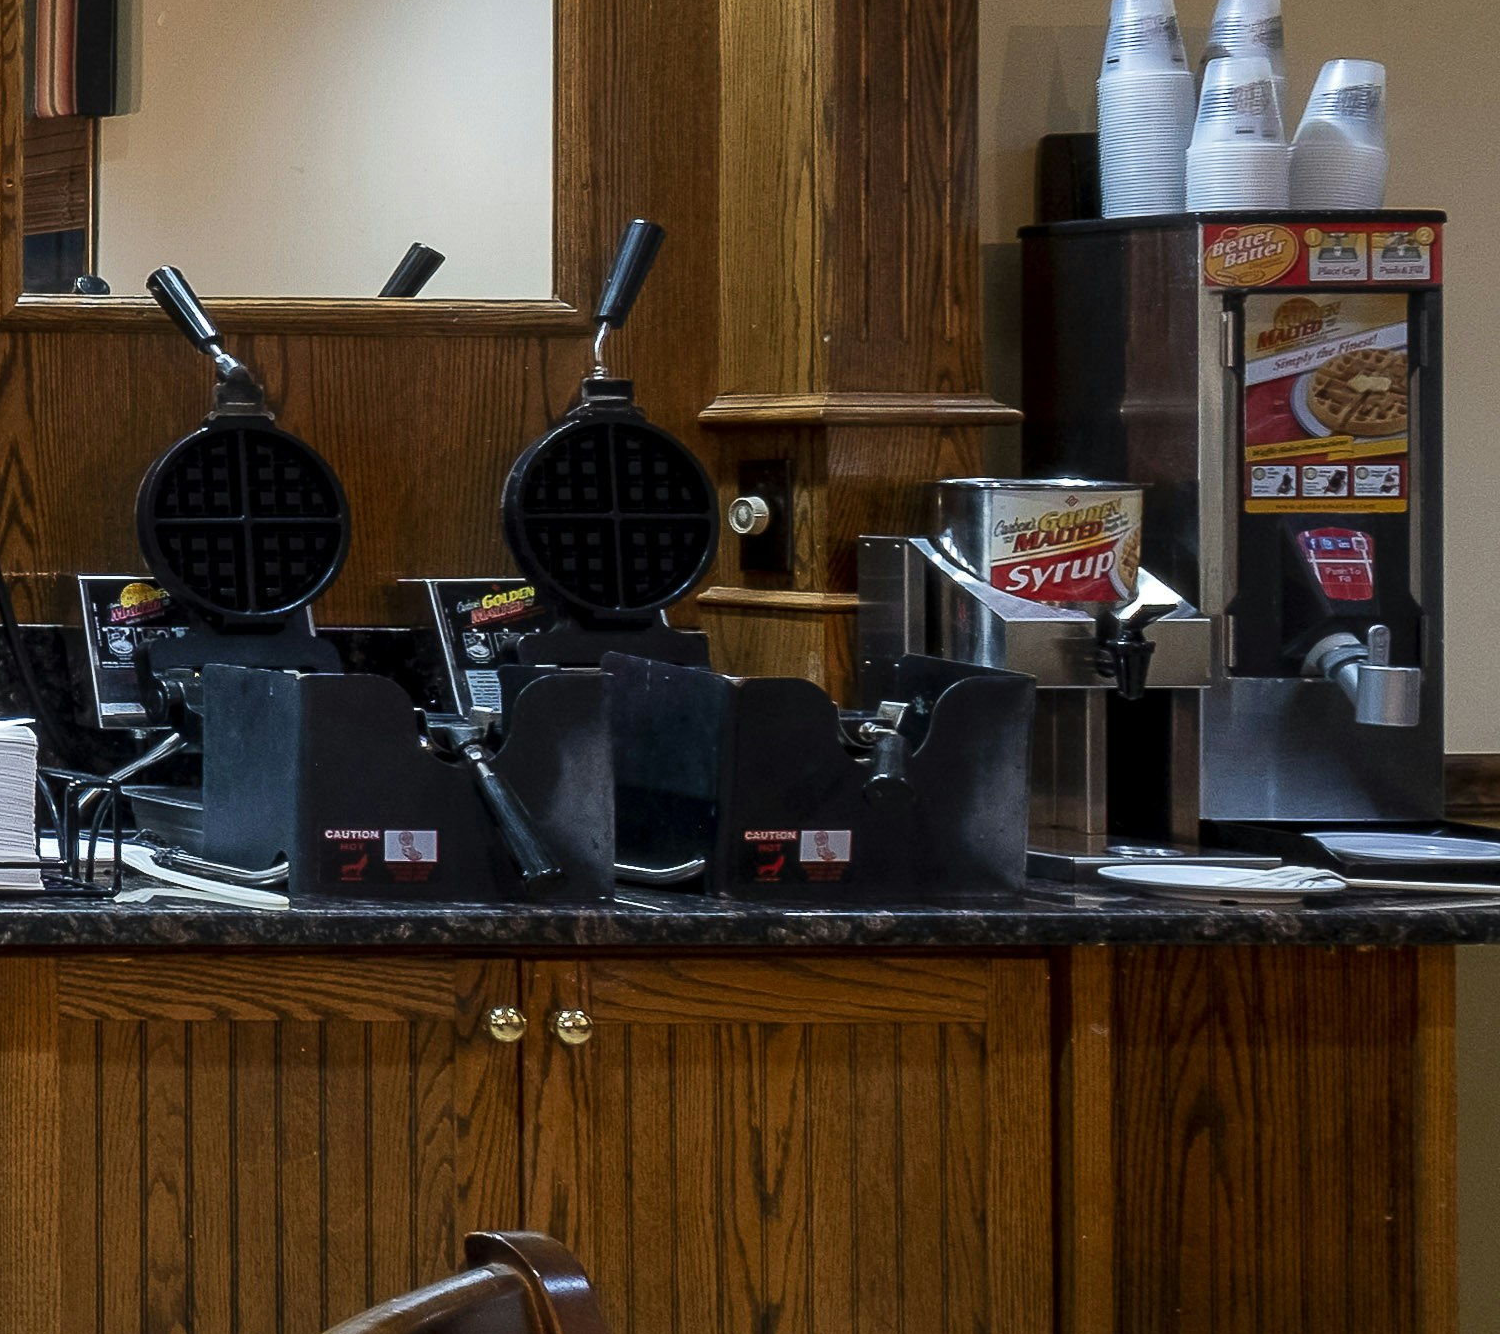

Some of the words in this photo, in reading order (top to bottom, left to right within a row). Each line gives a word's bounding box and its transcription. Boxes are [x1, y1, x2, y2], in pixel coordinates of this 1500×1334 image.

[1212, 230, 1275, 257] Better
[1224, 241, 1286, 268] Batter
[1272, 350, 1315, 371] Simply
[1316, 347, 1336, 359] the
[1338, 332, 1379, 353] Finest!
[1037, 498, 1123, 533] GOLDEN
[1012, 520, 1105, 554] MALTED
[1005, 550, 1116, 594] Syrup
[481, 586, 535, 610] GOLDEN
[324, 829, 380, 840] CAUTION
[340, 843, 365, 851] HOT
[744, 831, 798, 841] CAUTION
[757, 844, 782, 852] HOT
